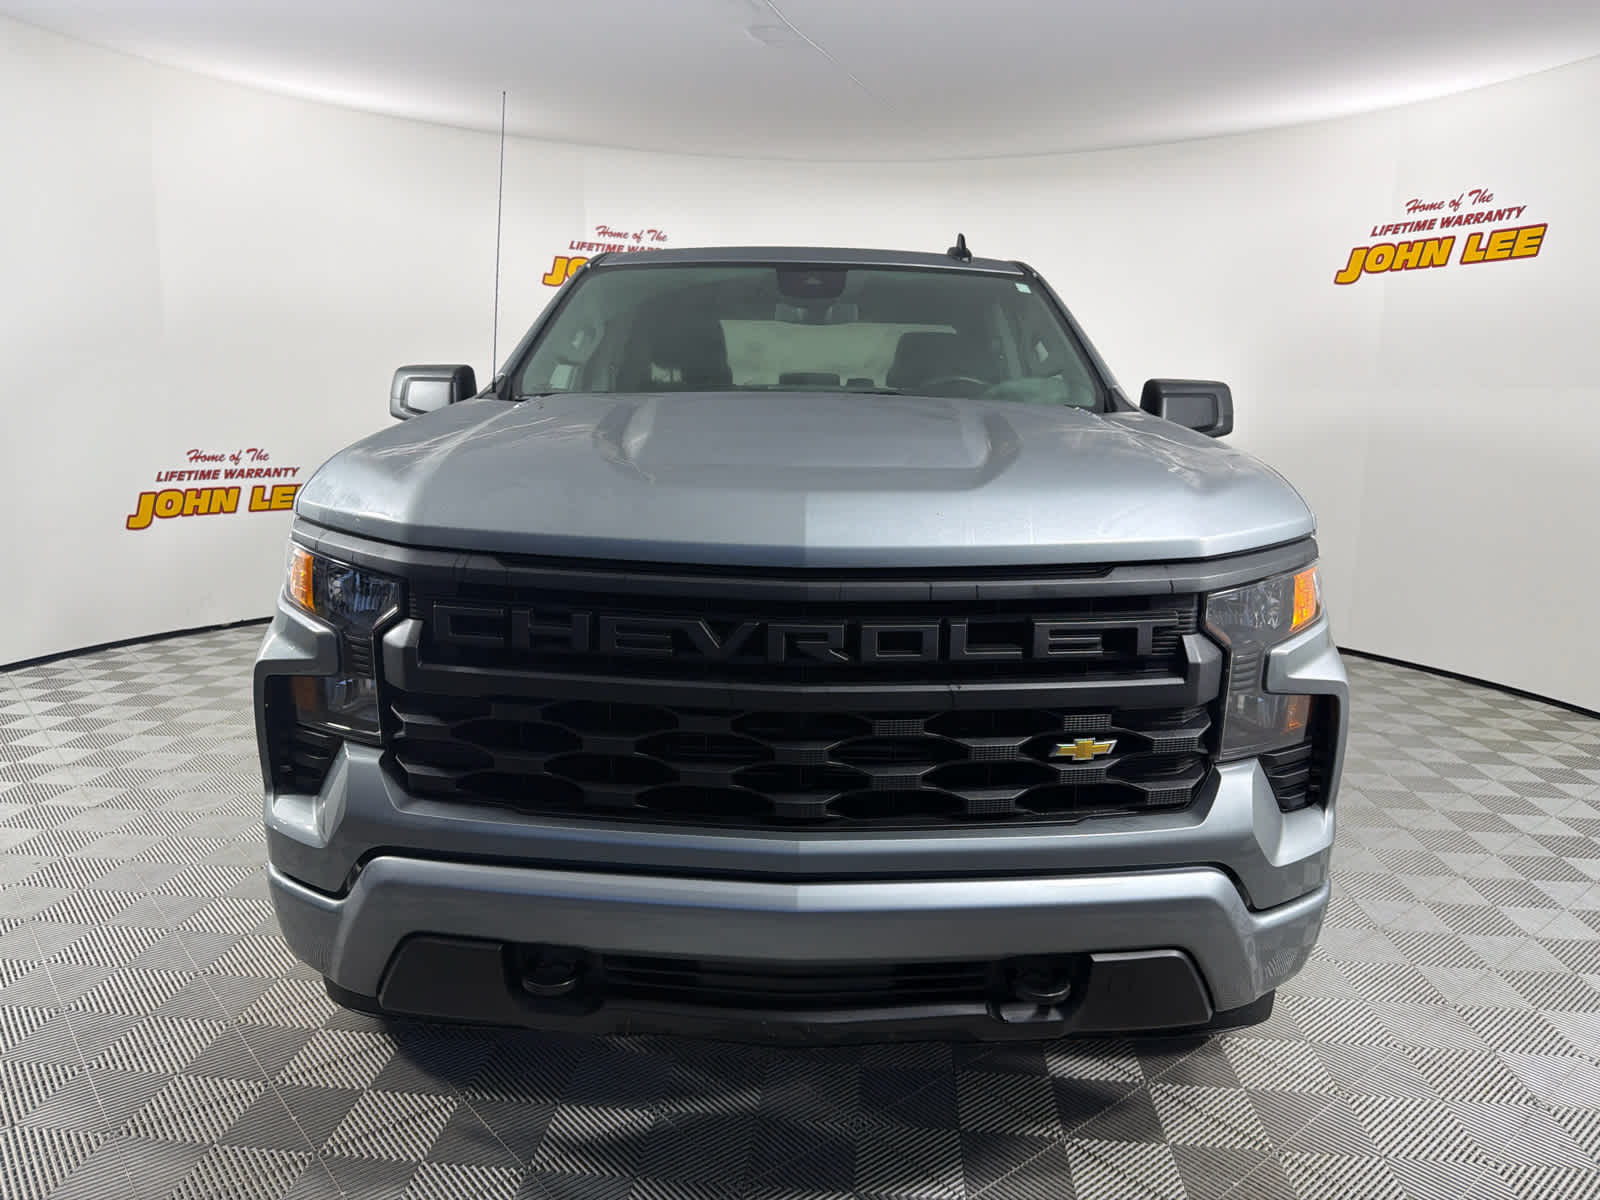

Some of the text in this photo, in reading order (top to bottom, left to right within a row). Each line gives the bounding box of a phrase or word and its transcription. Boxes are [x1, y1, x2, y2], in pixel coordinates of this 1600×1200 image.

[1405, 188, 1494, 215] Home of The
[595, 225, 668, 244] Home of The
[1370, 205, 1527, 238] LIFETIME WARRANTY
[568, 240, 625, 254] LIFETIME
[1333, 223, 1548, 285] JOHN LEE
[542, 255, 590, 287] JO
[186, 448, 270, 465] Home of The
[155, 467, 301, 483] LIFETIME WARRANTY
[126, 484, 304, 530] JOHN LE
[431, 601, 1180, 664] CHEVROLET
